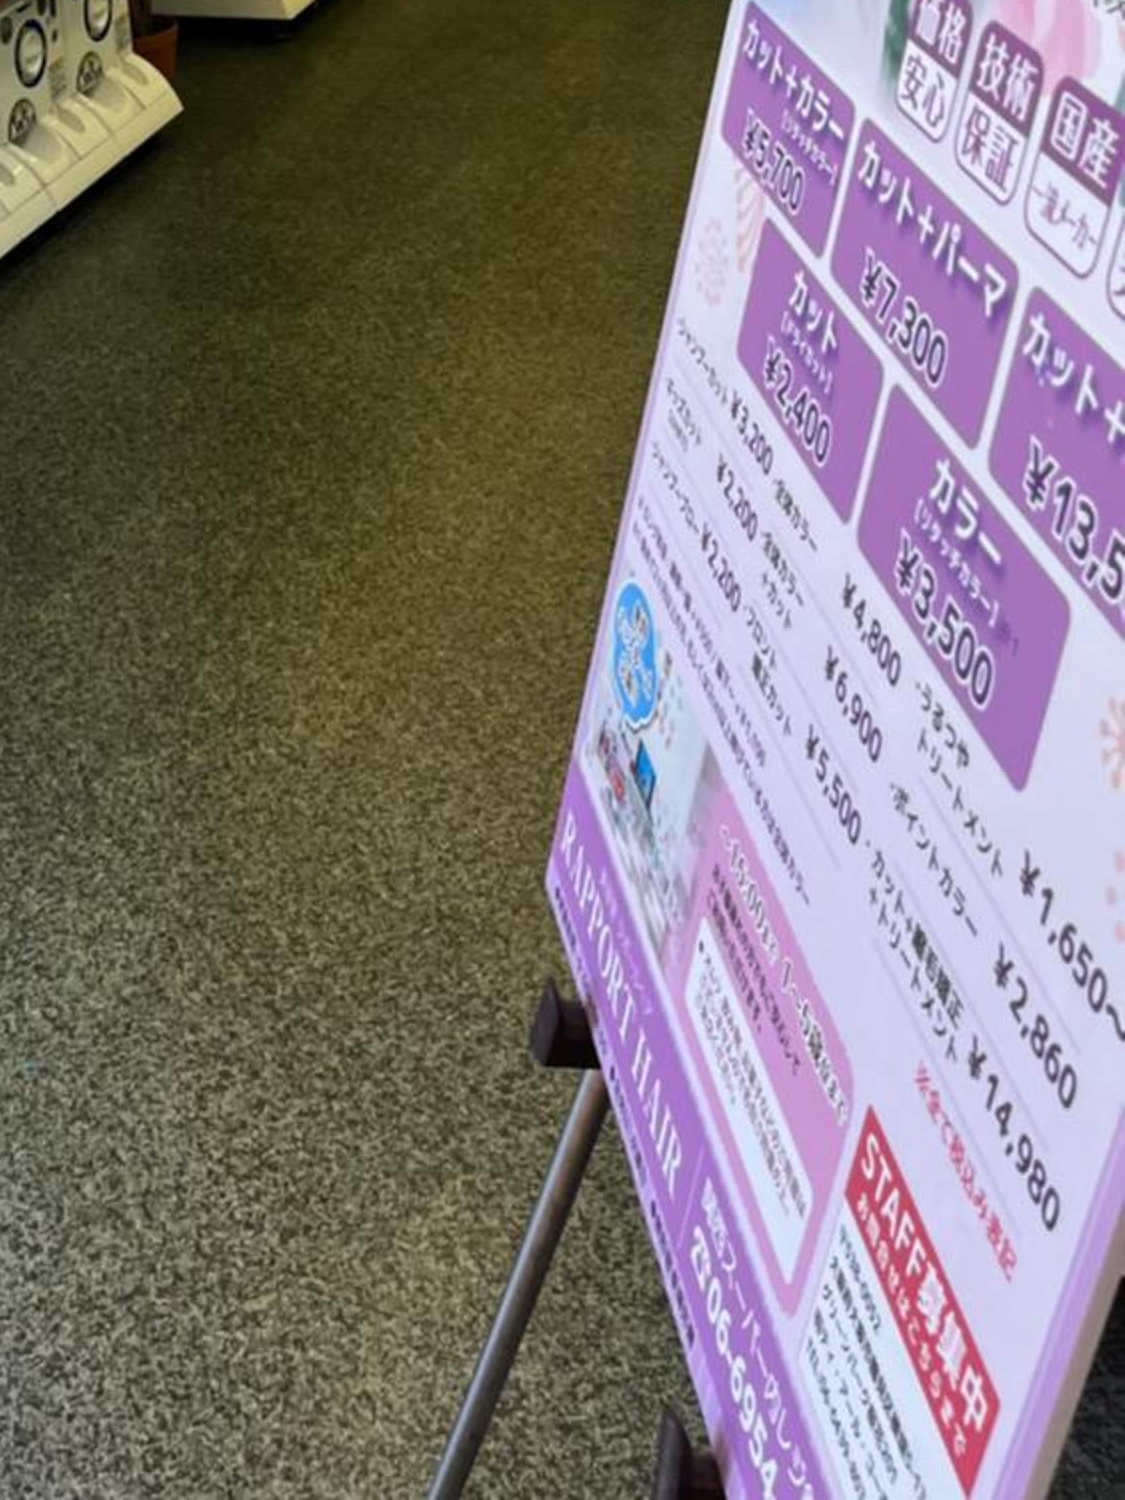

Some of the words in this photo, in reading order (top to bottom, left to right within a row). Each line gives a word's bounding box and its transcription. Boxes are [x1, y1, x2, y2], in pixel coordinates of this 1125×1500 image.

[902, 53, 946, 128] 安心
[977, 33, 1039, 121] 技術
[1051, 91, 1120, 189] 国産
[743, 108, 806, 216] ¥5,700
[960, 102, 1019, 194] 保証
[858, 140, 1008, 317] カット+パーマ
[790, 270, 841, 353] カット
[860, 250, 948, 386] ¥7,300
[764, 338, 831, 466] ¥2,400
[731, 389, 773, 475] ¥3,200
[844, 572, 902, 687] ¥4,800
[931, 459, 1004, 565] カラー
[1024, 438, 1125, 605] ¥13,5
[895, 528, 994, 709] ¥3,500
[716, 451, 759, 542] ¥2,200
[825, 643, 882, 764] ¥6,900
[993, 941, 1078, 1110] ¥2,860
[917, 728, 1004, 879] トリートメント
[701, 521, 742, 613] ¥2,200
[805, 722, 861, 845] ¥5,500
[968, 1034, 1061, 1232] ¥14,980
[559, 812, 639, 1042] RAPPORT
[630, 1027, 683, 1199] HAIR
